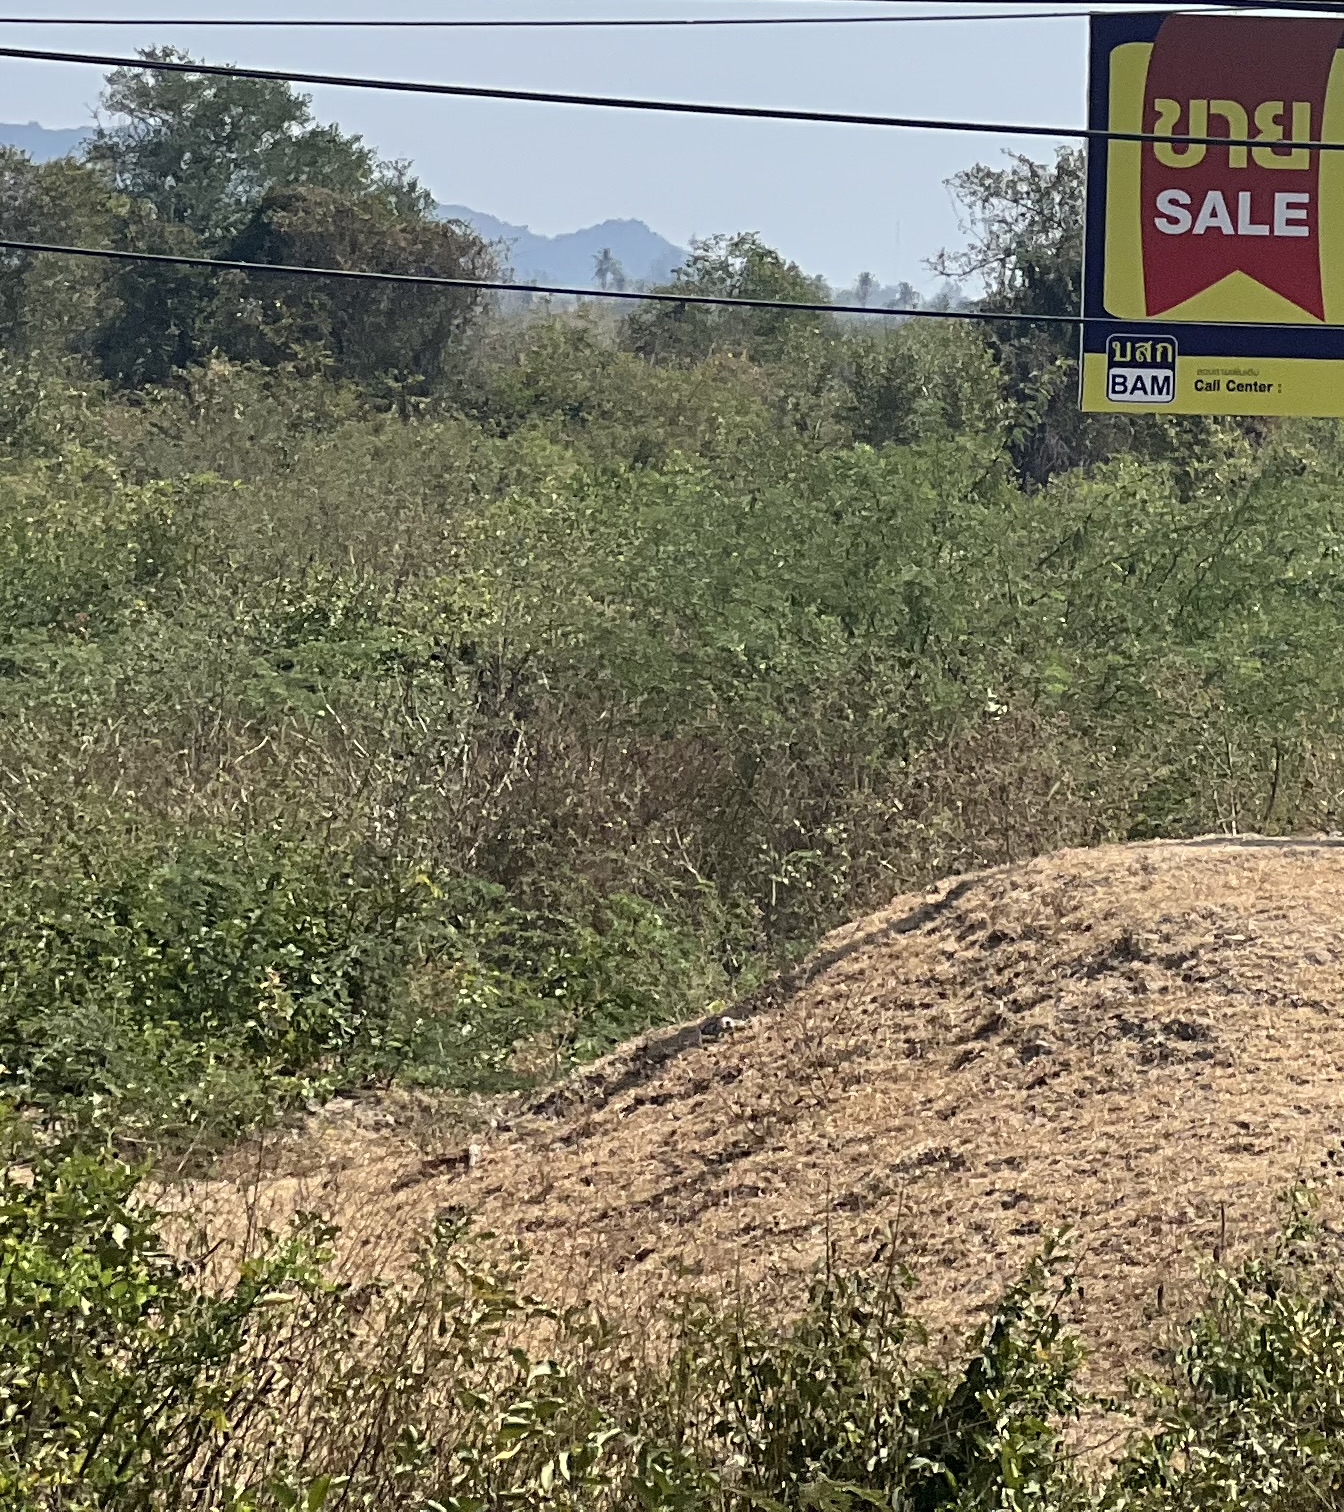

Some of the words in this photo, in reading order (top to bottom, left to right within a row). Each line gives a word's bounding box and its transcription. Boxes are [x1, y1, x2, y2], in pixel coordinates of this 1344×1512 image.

[1153, 98, 1311, 170] ขาย
[1153, 188, 1310, 237] SALE
[1112, 340, 1173, 363] บสก
[1110, 374, 1171, 396] BAM
[1194, 379, 1220, 392] Call
[1225, 380, 1273, 393] Center
